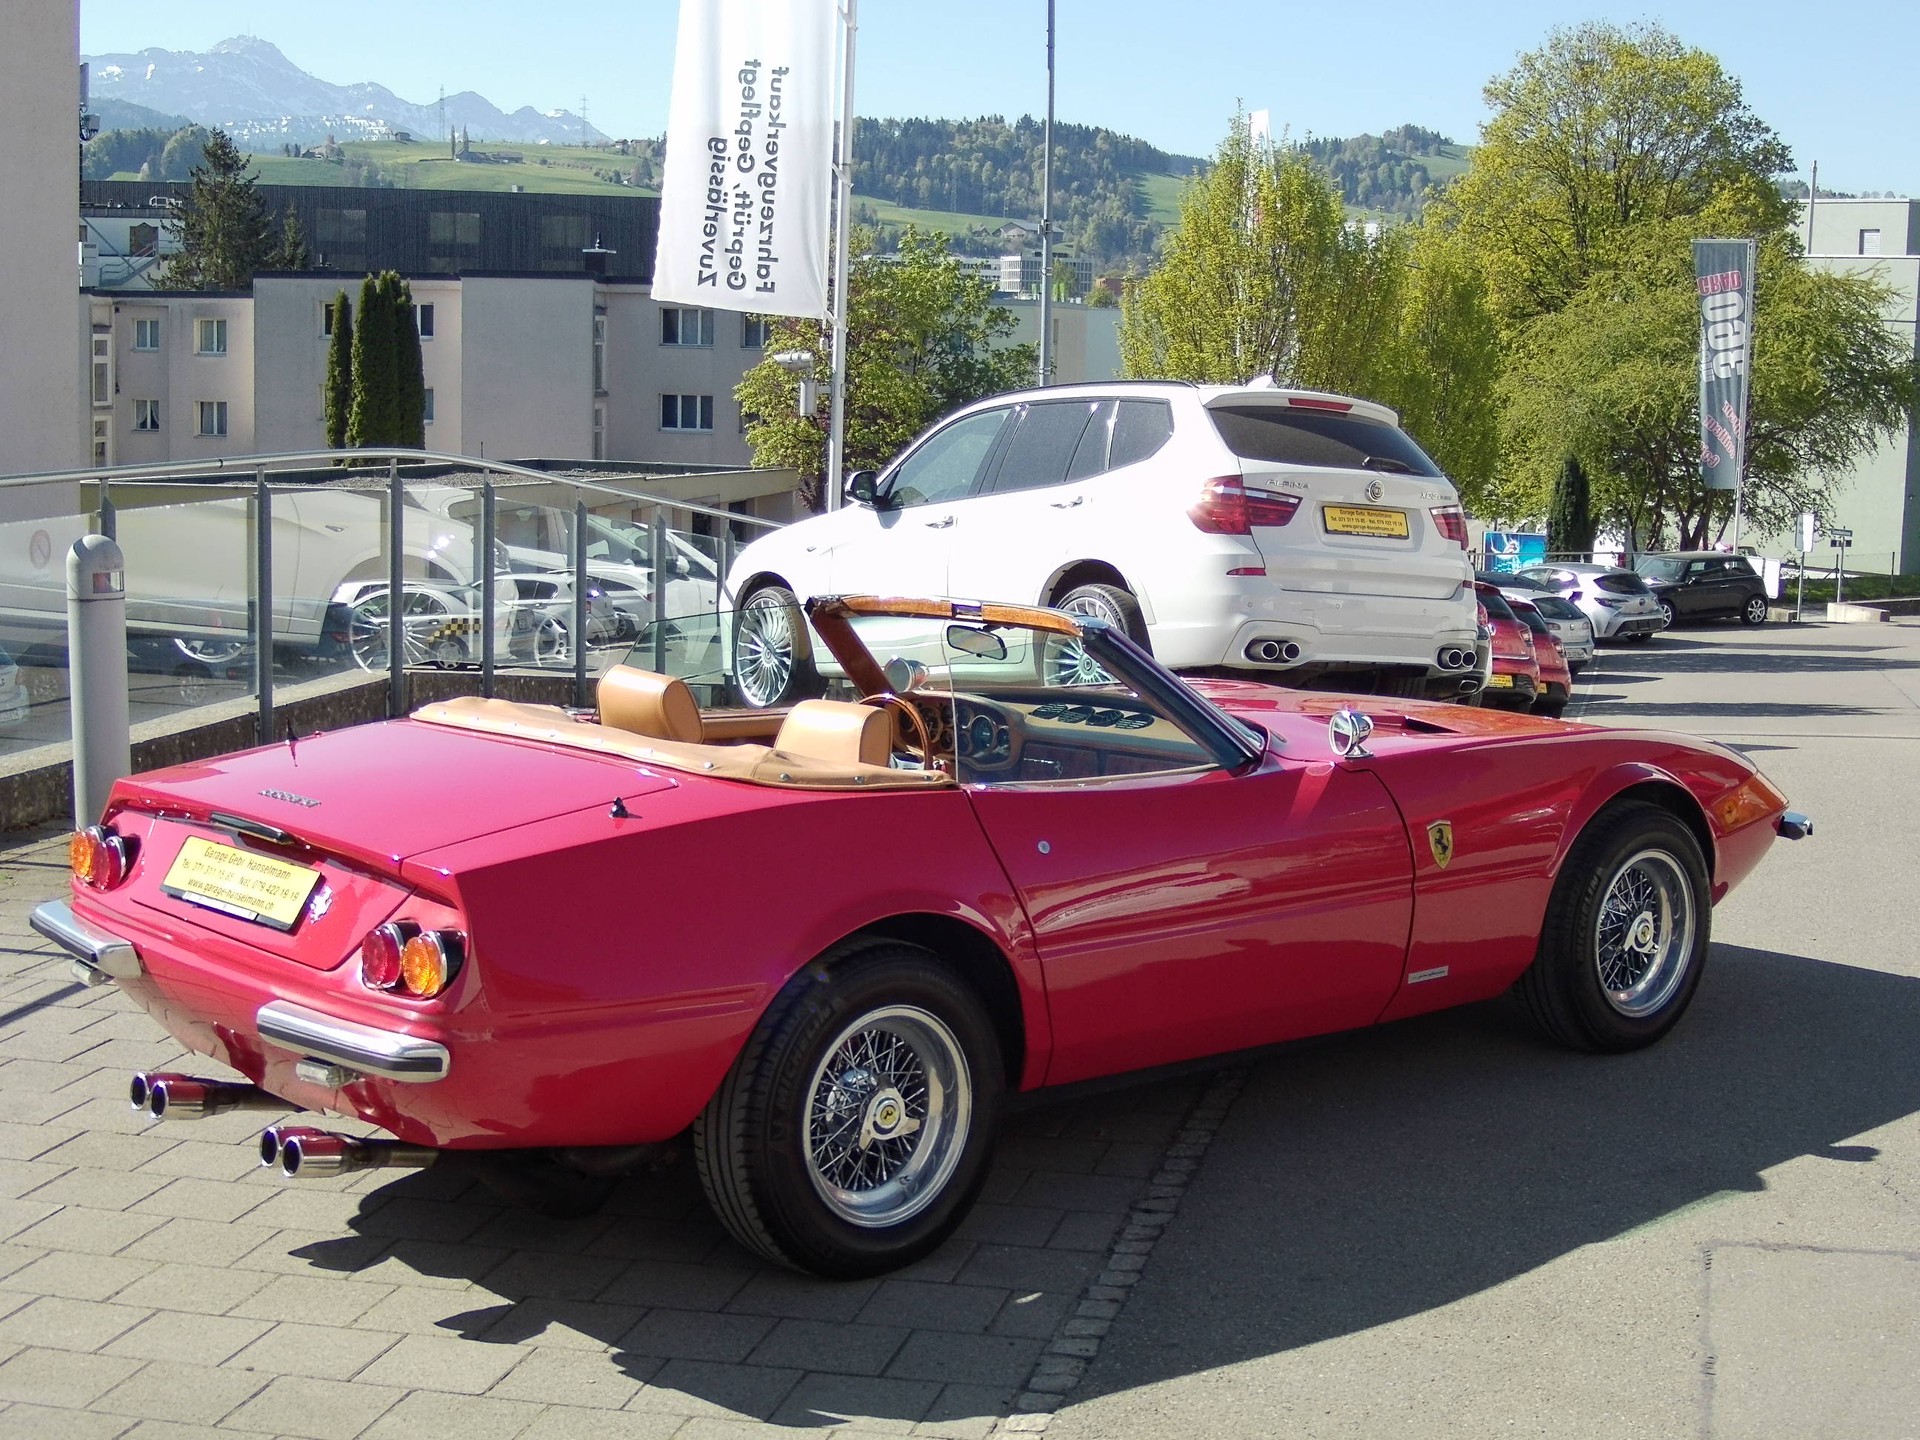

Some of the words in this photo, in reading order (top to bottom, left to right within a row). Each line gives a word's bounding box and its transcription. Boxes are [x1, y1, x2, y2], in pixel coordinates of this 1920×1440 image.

[1264, 479, 1311, 489] ALPINA
[204, 846, 228, 864] Garage
[247, 859, 291, 880] Hanselmann
[266, 884, 280, 896] 422
